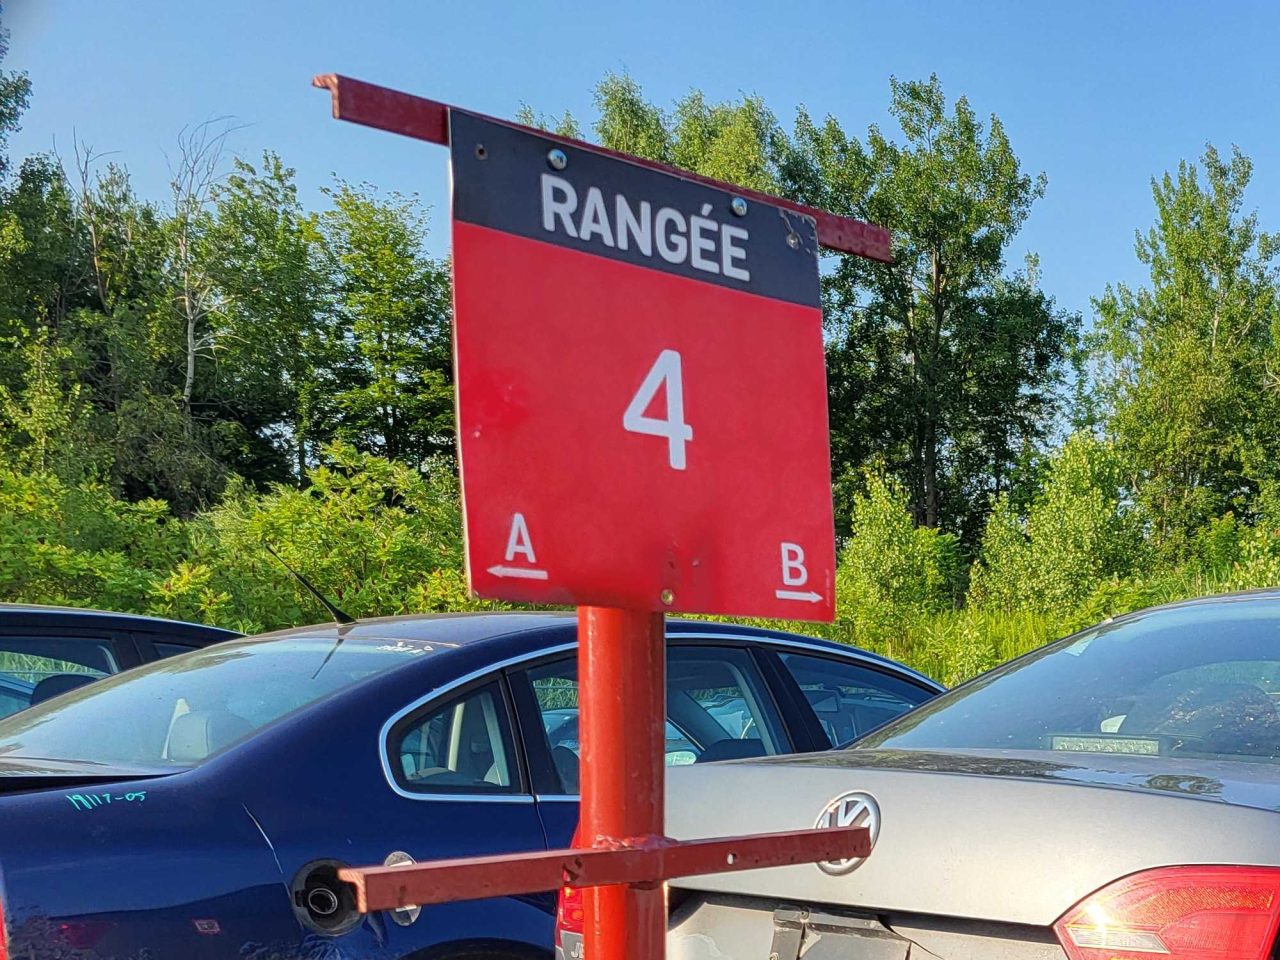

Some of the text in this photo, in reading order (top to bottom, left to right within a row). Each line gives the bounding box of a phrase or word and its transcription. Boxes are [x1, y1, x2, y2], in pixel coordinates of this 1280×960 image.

[540, 173, 751, 283] RANGÉE
[622, 348, 694, 471] 4
[504, 512, 537, 564] A
[780, 542, 809, 587] B
